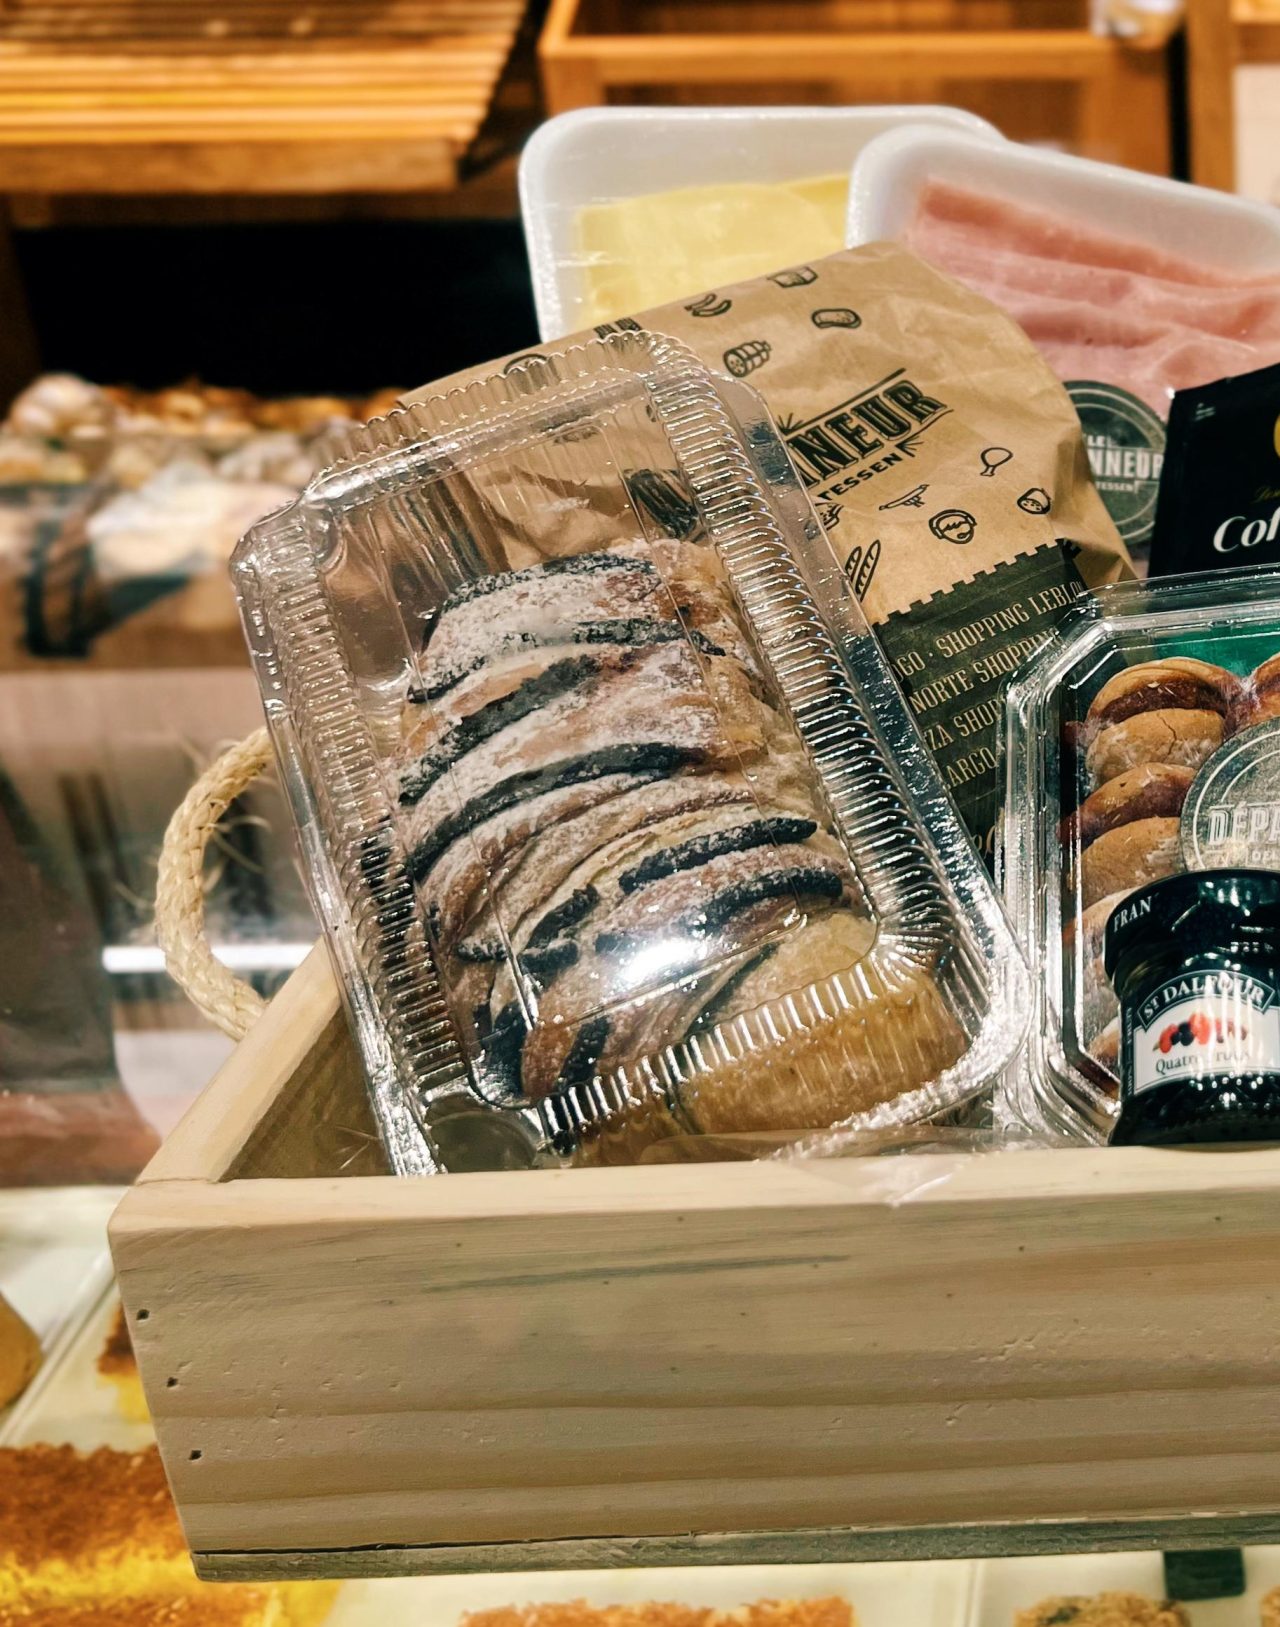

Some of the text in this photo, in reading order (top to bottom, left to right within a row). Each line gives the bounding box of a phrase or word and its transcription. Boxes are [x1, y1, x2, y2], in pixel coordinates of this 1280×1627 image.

[934, 603, 1030, 659] SHOPPING
[908, 670, 975, 715] NORTE
[1163, 974, 1266, 1005] DALFOUR
[1155, 1054, 1198, 1076] Quatr
